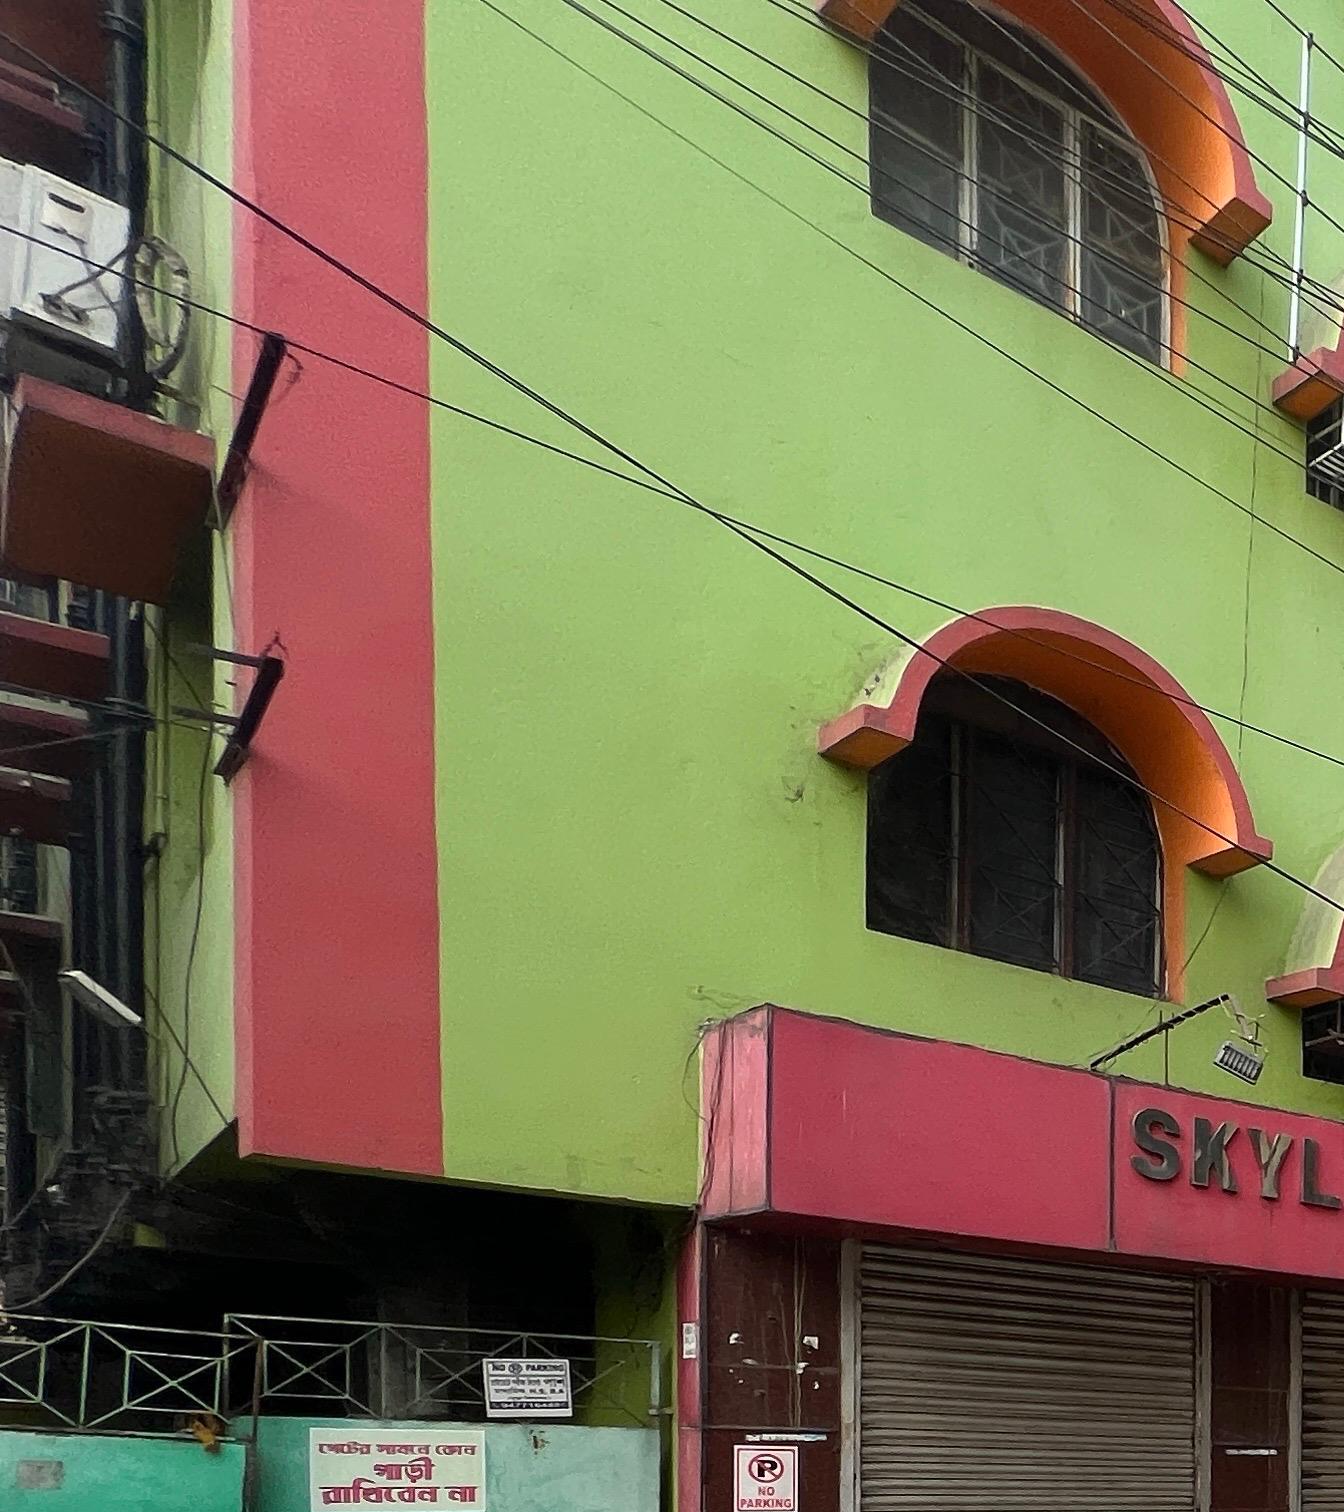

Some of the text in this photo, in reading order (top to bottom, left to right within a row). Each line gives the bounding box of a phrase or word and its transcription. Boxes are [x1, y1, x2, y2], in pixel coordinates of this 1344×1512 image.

[444, 1486, 478, 1502] না
[758, 1487, 775, 1495] NO
[740, 1499, 792, 1508] PARKING
